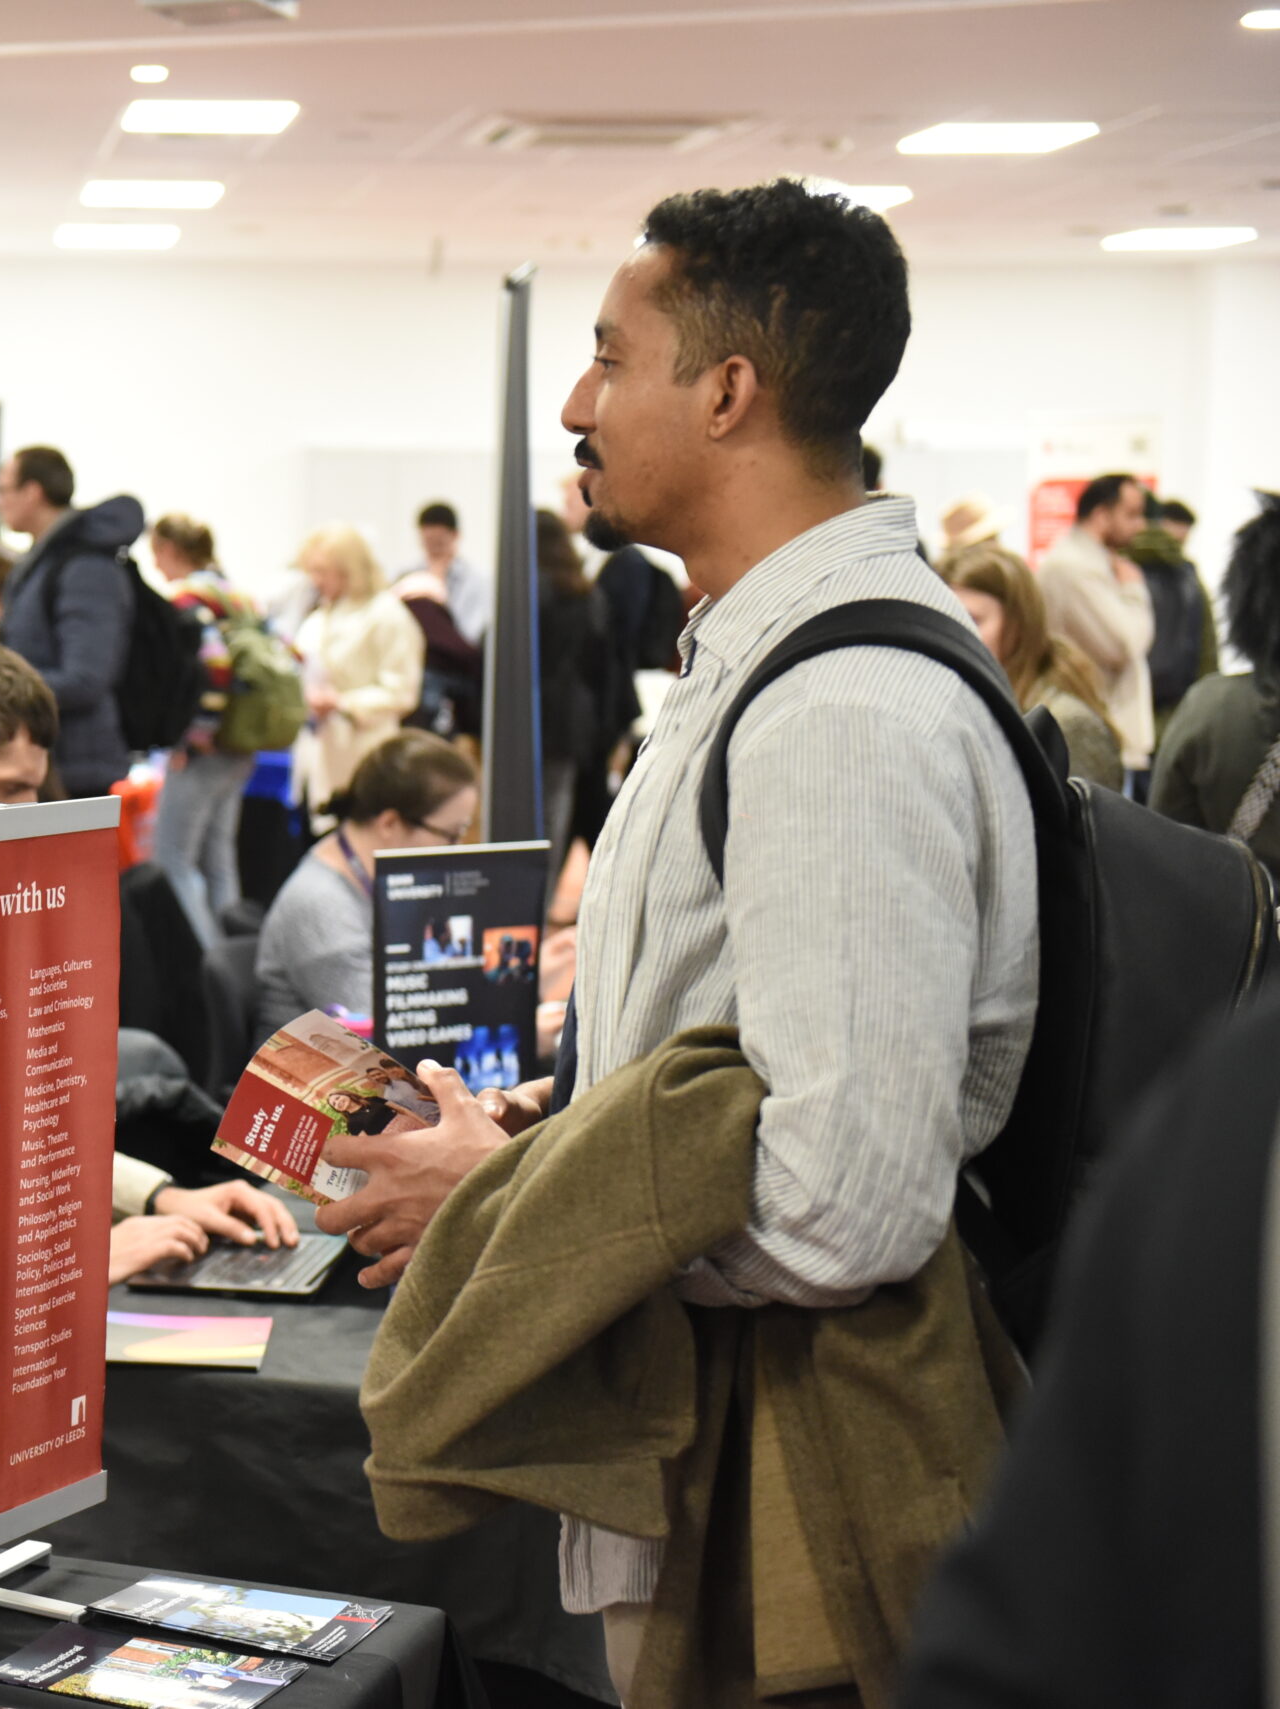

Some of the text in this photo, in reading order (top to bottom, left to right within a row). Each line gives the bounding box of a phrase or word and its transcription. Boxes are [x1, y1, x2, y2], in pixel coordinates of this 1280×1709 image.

[0, 880, 43, 916] with
[46, 885, 66, 910] us
[30, 959, 93, 981] Languages, Cultures
[385, 972, 428, 992] MUSIC
[29, 979, 68, 997] and Societies
[29, 995, 94, 1018] Law and Criminology
[386, 1008, 437, 1029] ACTING
[28, 1020, 65, 1039] Mathematics
[385, 1023, 473, 1048] VIDEO GAMES
[27, 1041, 58, 1060] Media and
[26, 1056, 73, 1077] Communication
[25, 1074, 88, 1098] Medicine, Dentistry,
[24, 1091, 70, 1115] Healthcare and
[23, 1114, 60, 1133] Psychology
[244, 1107, 268, 1147] Study
[258, 1104, 285, 1152] with us.
[22, 1131, 69, 1152] Music, Theatre
[21, 1145, 75, 1169] and Performance
[20, 1163, 81, 1190] Nursing, Midwifery
[326, 1169, 337, 1186] Top
[19, 1181, 71, 1207] and Social Work
[19, 1199, 82, 1228] Philosophy, Religion
[18, 1217, 77, 1245] and Applied Ethics
[17, 1237, 71, 1266] Sociology, Social
[16, 1251, 76, 1282] Policy, Politics and
[16, 1267, 83, 1298] International Studies
[15, 1290, 76, 1322] Sport and Exercise
[14, 1319, 47, 1337] Sciences
[14, 1328, 72, 1356] Transport Studies
[13, 1352, 57, 1378] International
[12, 1367, 67, 1395] Foundation Year
[10, 1425, 86, 1466] UNIVERSITY OF LEEDS
